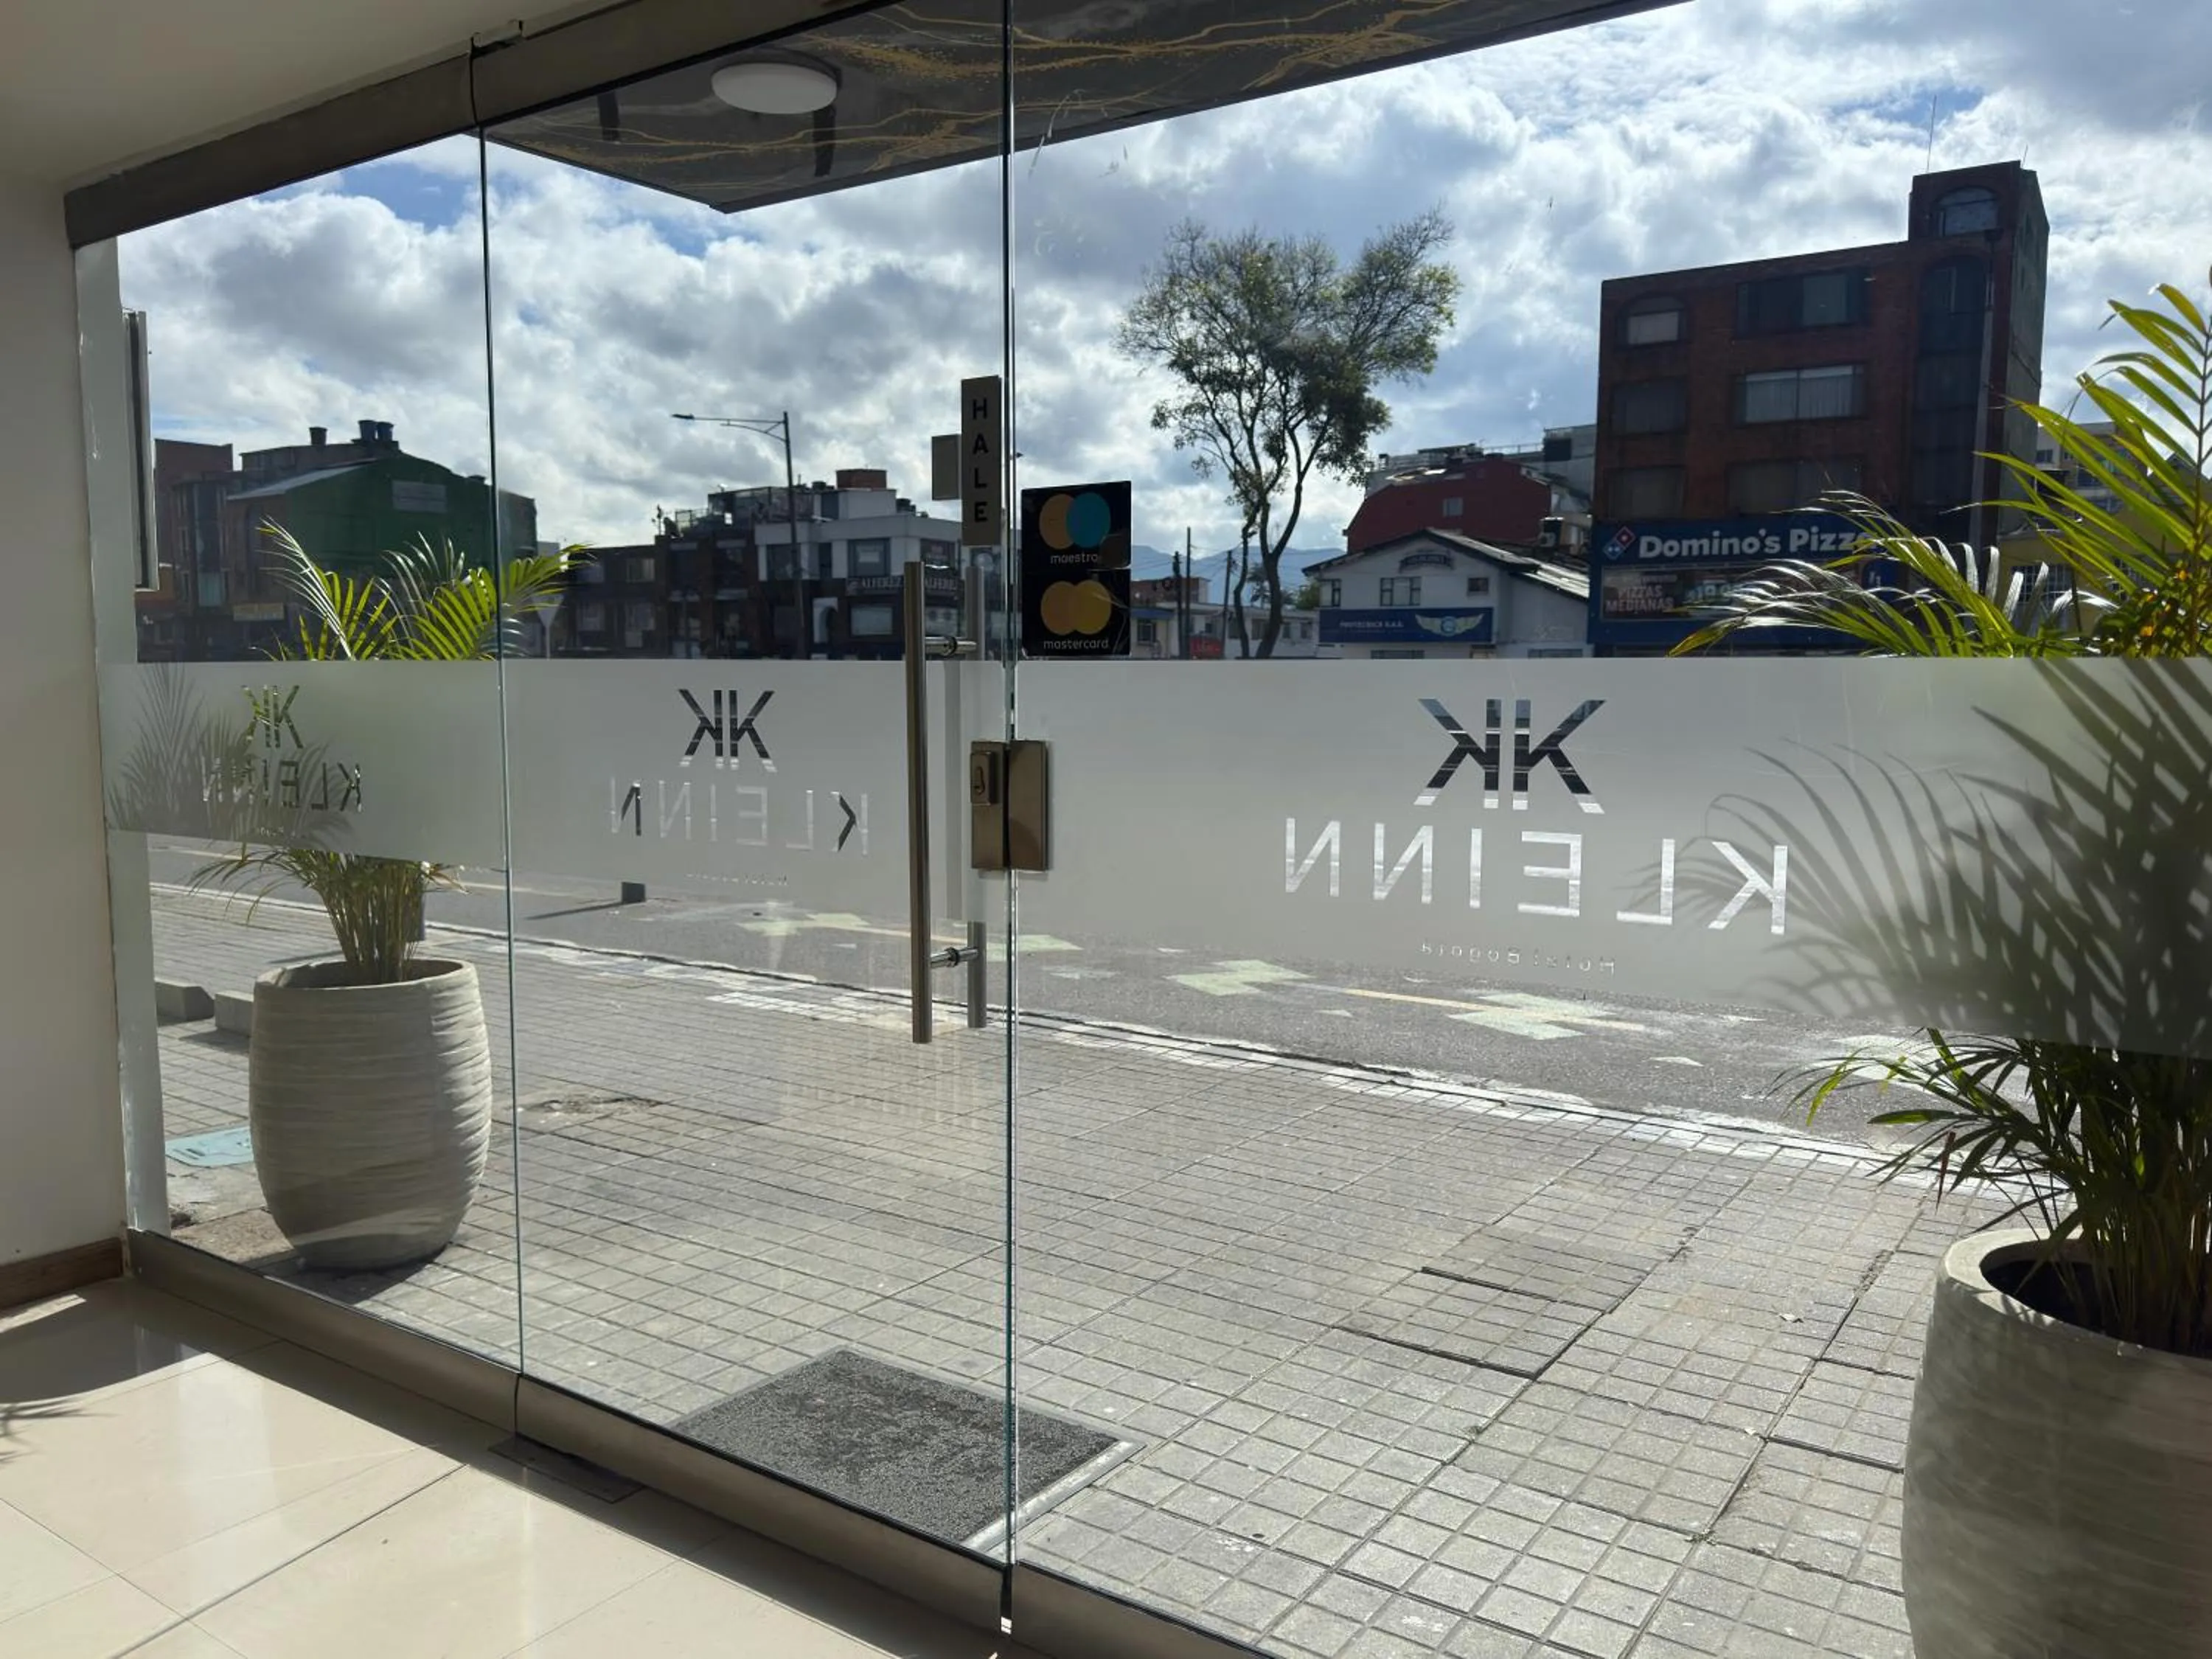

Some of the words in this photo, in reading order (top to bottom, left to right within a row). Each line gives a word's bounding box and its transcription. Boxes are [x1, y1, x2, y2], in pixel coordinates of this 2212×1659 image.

[973, 399, 990, 523] HALE
[1639, 528, 1781, 559] Domino's
[1050, 552, 1099, 565] maestro
[1043, 638, 1110, 650] mastercard
